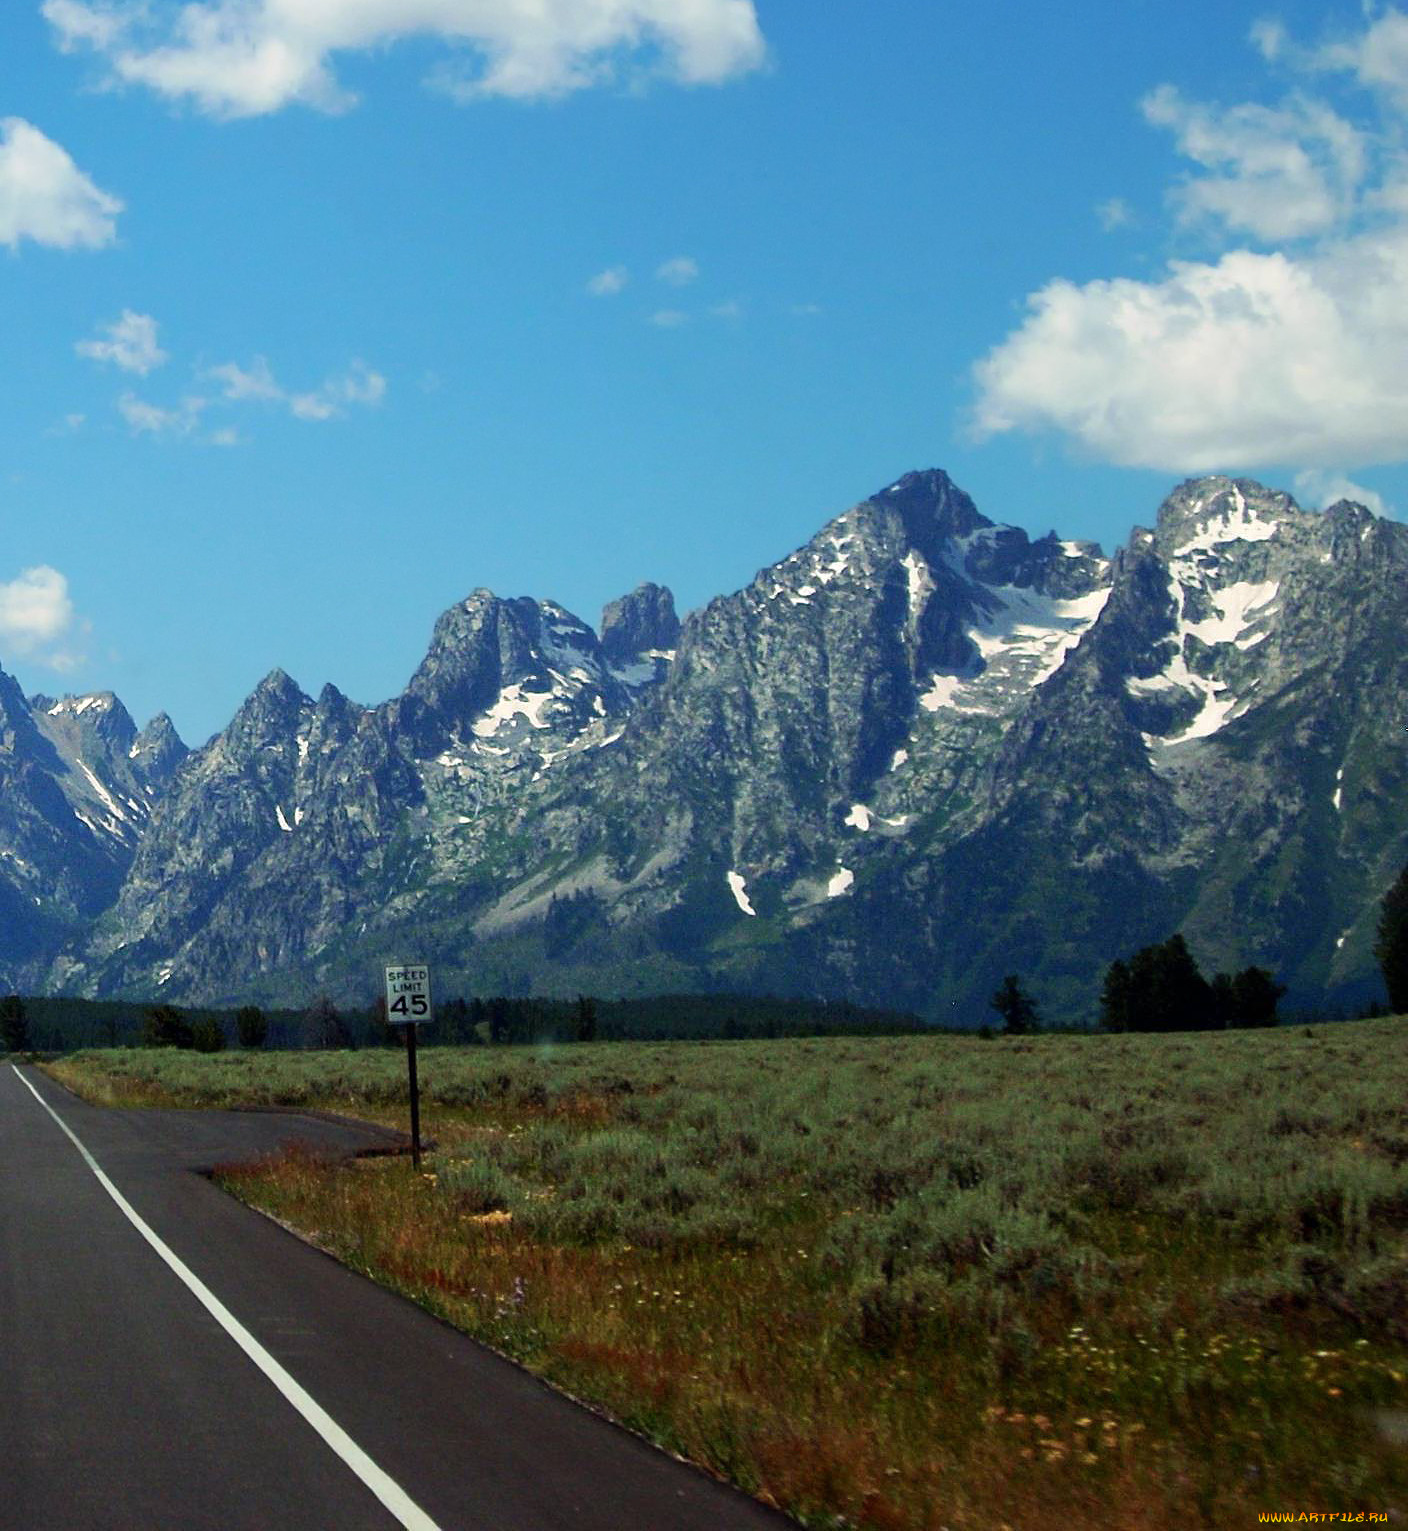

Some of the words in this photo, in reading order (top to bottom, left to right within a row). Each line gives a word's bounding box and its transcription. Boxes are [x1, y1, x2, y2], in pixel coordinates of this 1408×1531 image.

[388, 970, 427, 981] SPEED
[393, 982, 422, 993] LIMIT
[390, 994, 428, 1016] 45
